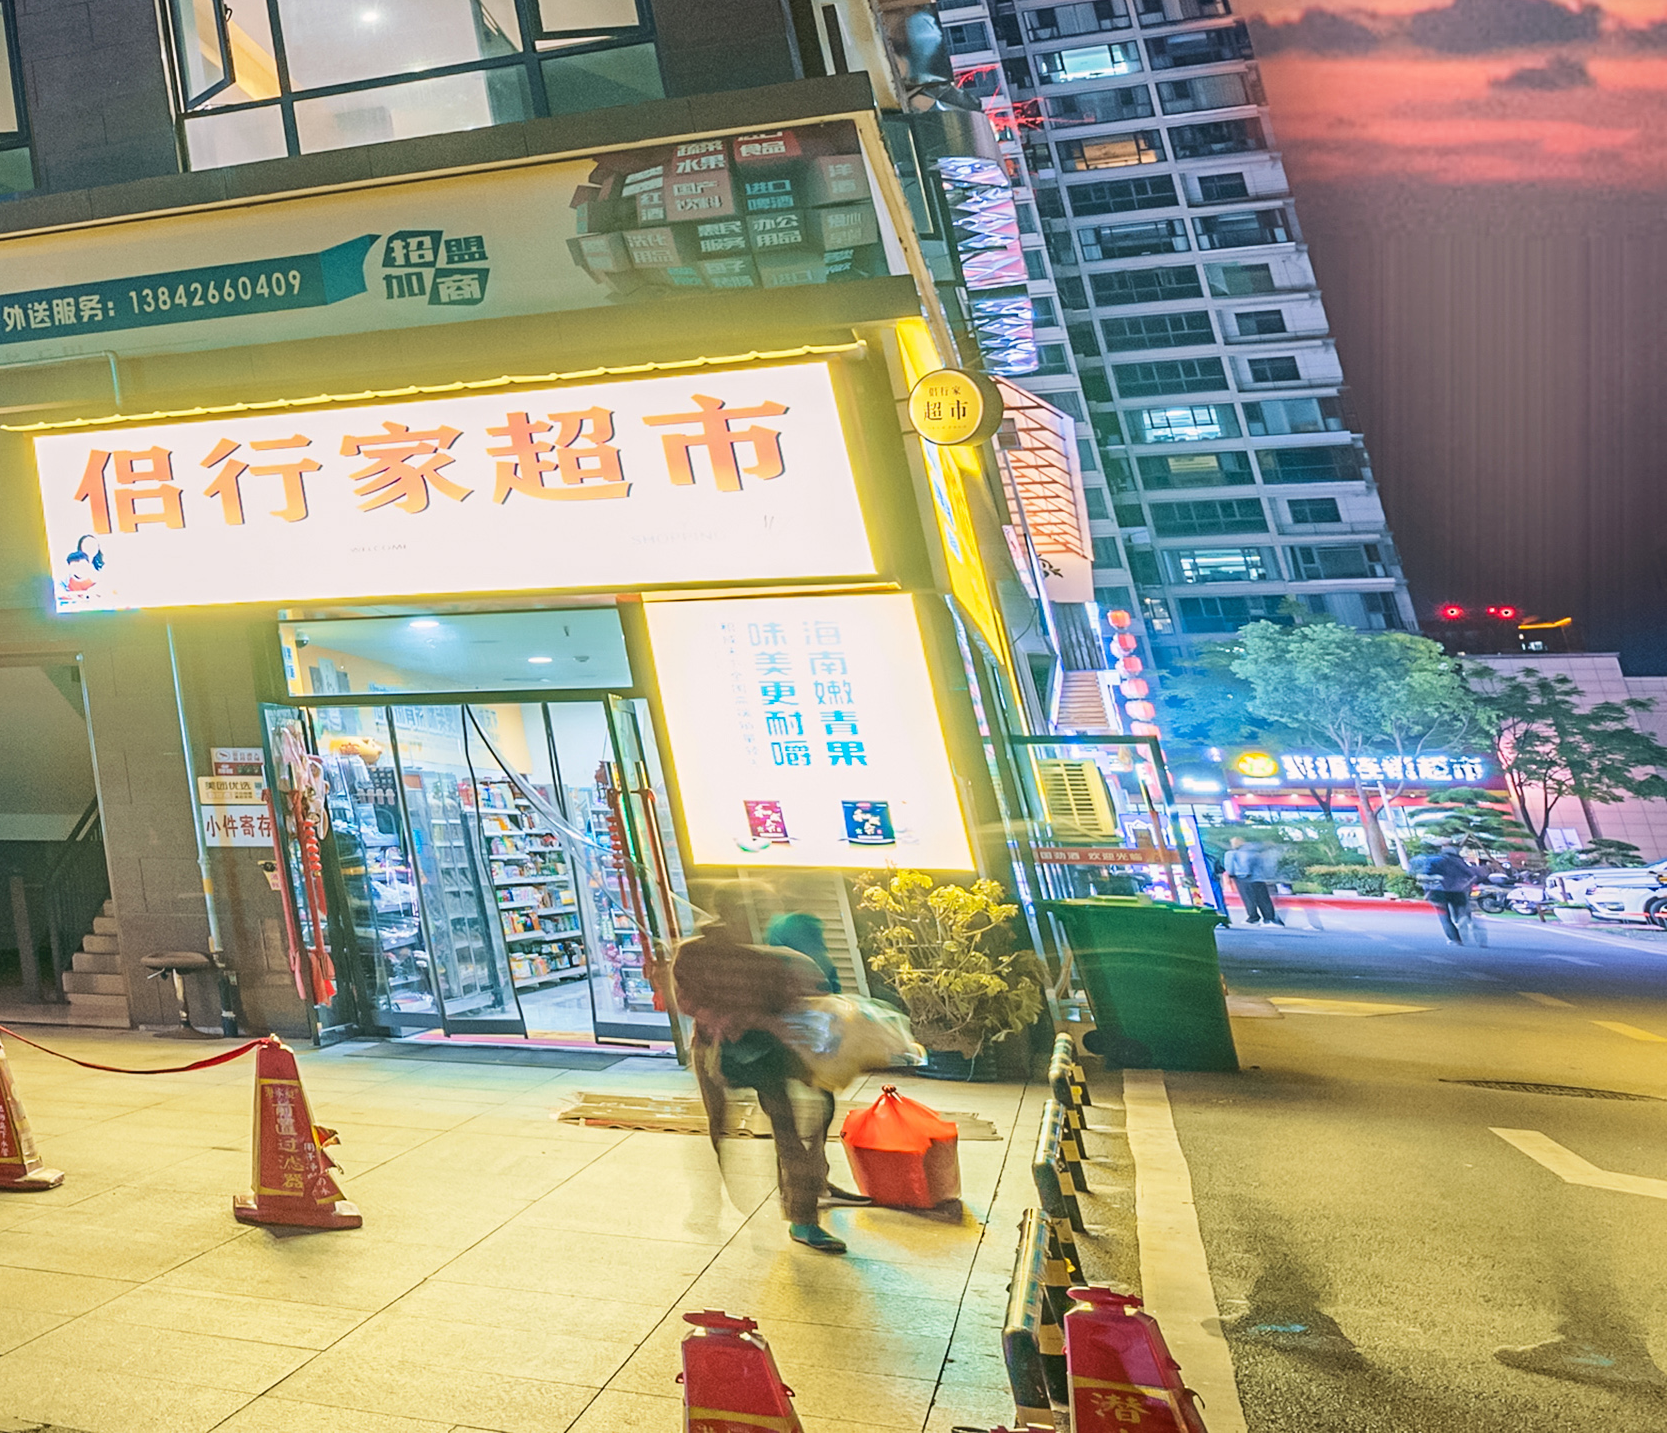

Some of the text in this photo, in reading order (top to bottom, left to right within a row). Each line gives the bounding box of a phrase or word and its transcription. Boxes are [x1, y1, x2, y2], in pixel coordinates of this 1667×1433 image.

[739, 140, 786, 157] 食品
[676, 154, 726, 174] 水果
[672, 180, 719, 196] 国产
[745, 179, 792, 196] 进口
[676, 195, 722, 212] 饮料
[697, 221, 743, 238] 惠民
[753, 213, 799, 231] 办公
[700, 236, 746, 253] 服务
[756, 230, 802, 248] 用品
[2, 268, 303, 332] 外送服务： 13842660409
[923, 399, 968, 421] 超市
[74, 393, 791, 537] 侣行家超市
[747, 620, 812, 767] 味美更耐嚼
[802, 620, 868, 767] 海南嫩青果
[206, 813, 272, 839] 小件寄存
[1087, 851, 1143, 862] 欢迎光临
